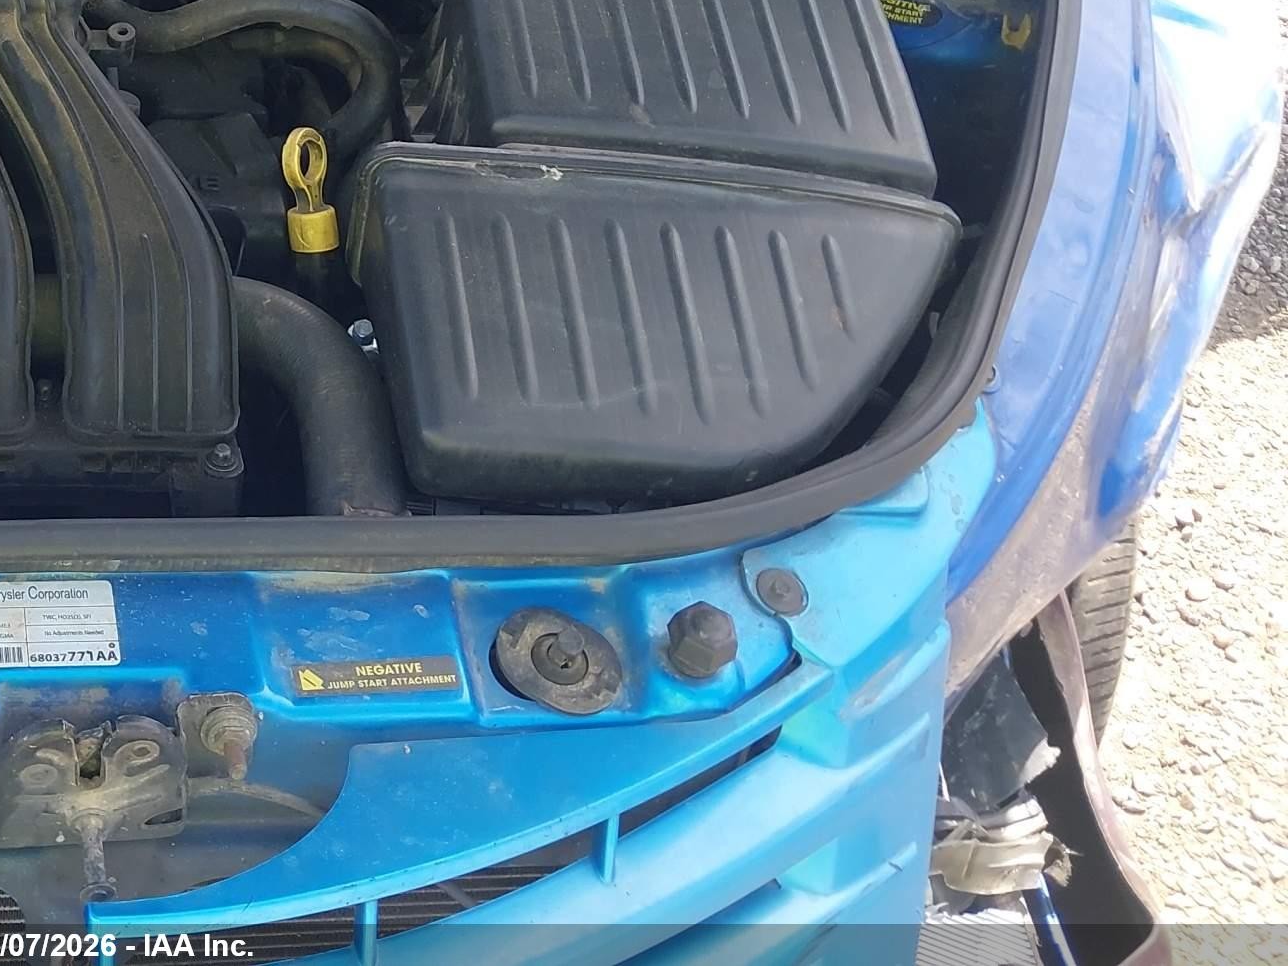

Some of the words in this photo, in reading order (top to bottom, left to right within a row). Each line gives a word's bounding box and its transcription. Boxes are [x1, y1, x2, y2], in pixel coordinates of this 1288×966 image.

[27, 585, 89, 601] Corporation
[30, 650, 118, 663] 68037771AA
[356, 662, 423, 677] NEGATIVE
[327, 680, 355, 690] JUMP
[358, 679, 388, 689] START
[391, 674, 456, 687] ATTACHMENT
